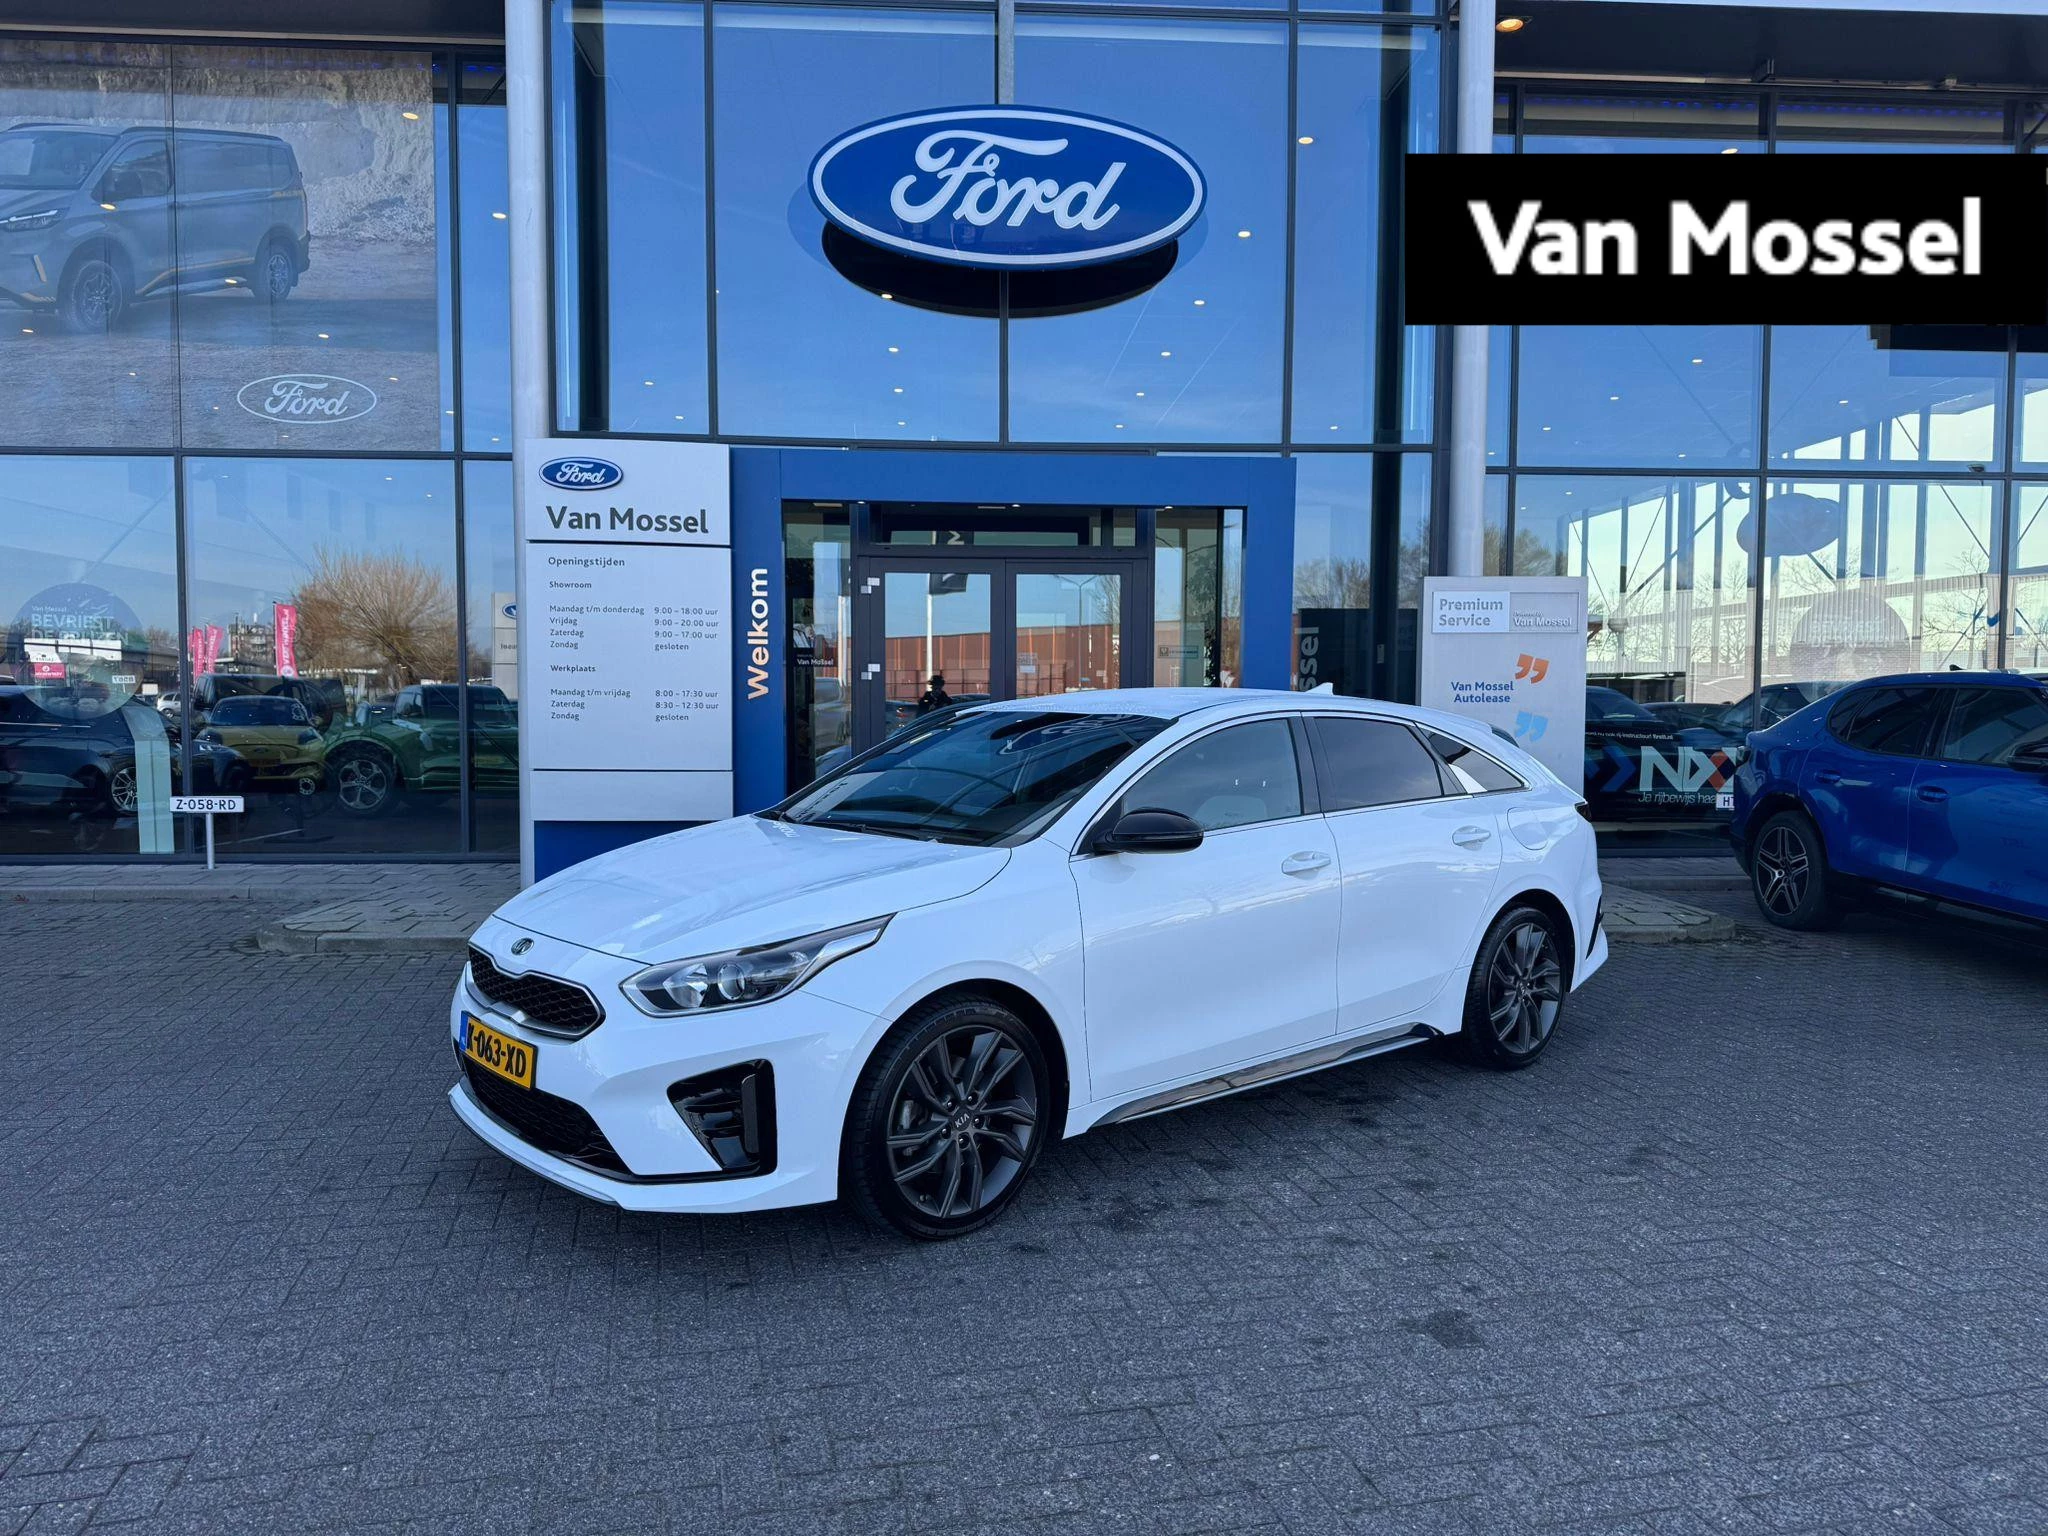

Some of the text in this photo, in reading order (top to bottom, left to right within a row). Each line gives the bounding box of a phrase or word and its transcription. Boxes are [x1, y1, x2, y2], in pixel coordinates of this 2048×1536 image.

[890, 129, 1127, 231] Ford
[264, 381, 352, 416] Ford
[556, 462, 607, 484] Ford
[546, 506, 709, 534] Van Mossel
[548, 556, 626, 568] Openingstijden
[549, 580, 593, 589] Showroom
[549, 604, 584, 614] Maandag
[586, 604, 601, 613] t/m
[603, 605, 645, 616] donderdag
[1439, 597, 1504, 611] Premium
[31, 613, 115, 630] BEVRIEST
[549, 616, 578, 626] Vrijdag
[1438, 613, 1491, 627] Service
[1514, 616, 1573, 627] Van Mossel
[550, 628, 584, 638] Zaterdag
[747, 568, 770, 700] Welkom
[550, 640, 689, 651] Zondag gesloten
[1294, 627, 1319, 692] ssel
[550, 664, 597, 674] Werkplaats
[1451, 681, 1514, 691] Van Mossel
[550, 688, 586, 698] Maandag
[587, 688, 602, 696] t/m
[603, 688, 632, 698] vrijdag
[655, 689, 674, 697] 8:00
[1454, 693, 1511, 703] Autolease
[551, 699, 586, 709] Zaterdag
[655, 701, 674, 709] 8:30
[682, 701, 704, 709] 12:30
[551, 711, 689, 722] Zondag gesloten
[176, 798, 236, 810] Z-058-RD
[1654, 791, 1696, 805] rijbewijs
[1697, 792, 1717, 804] haa
[466, 1022, 527, 1078] K-063-XD
